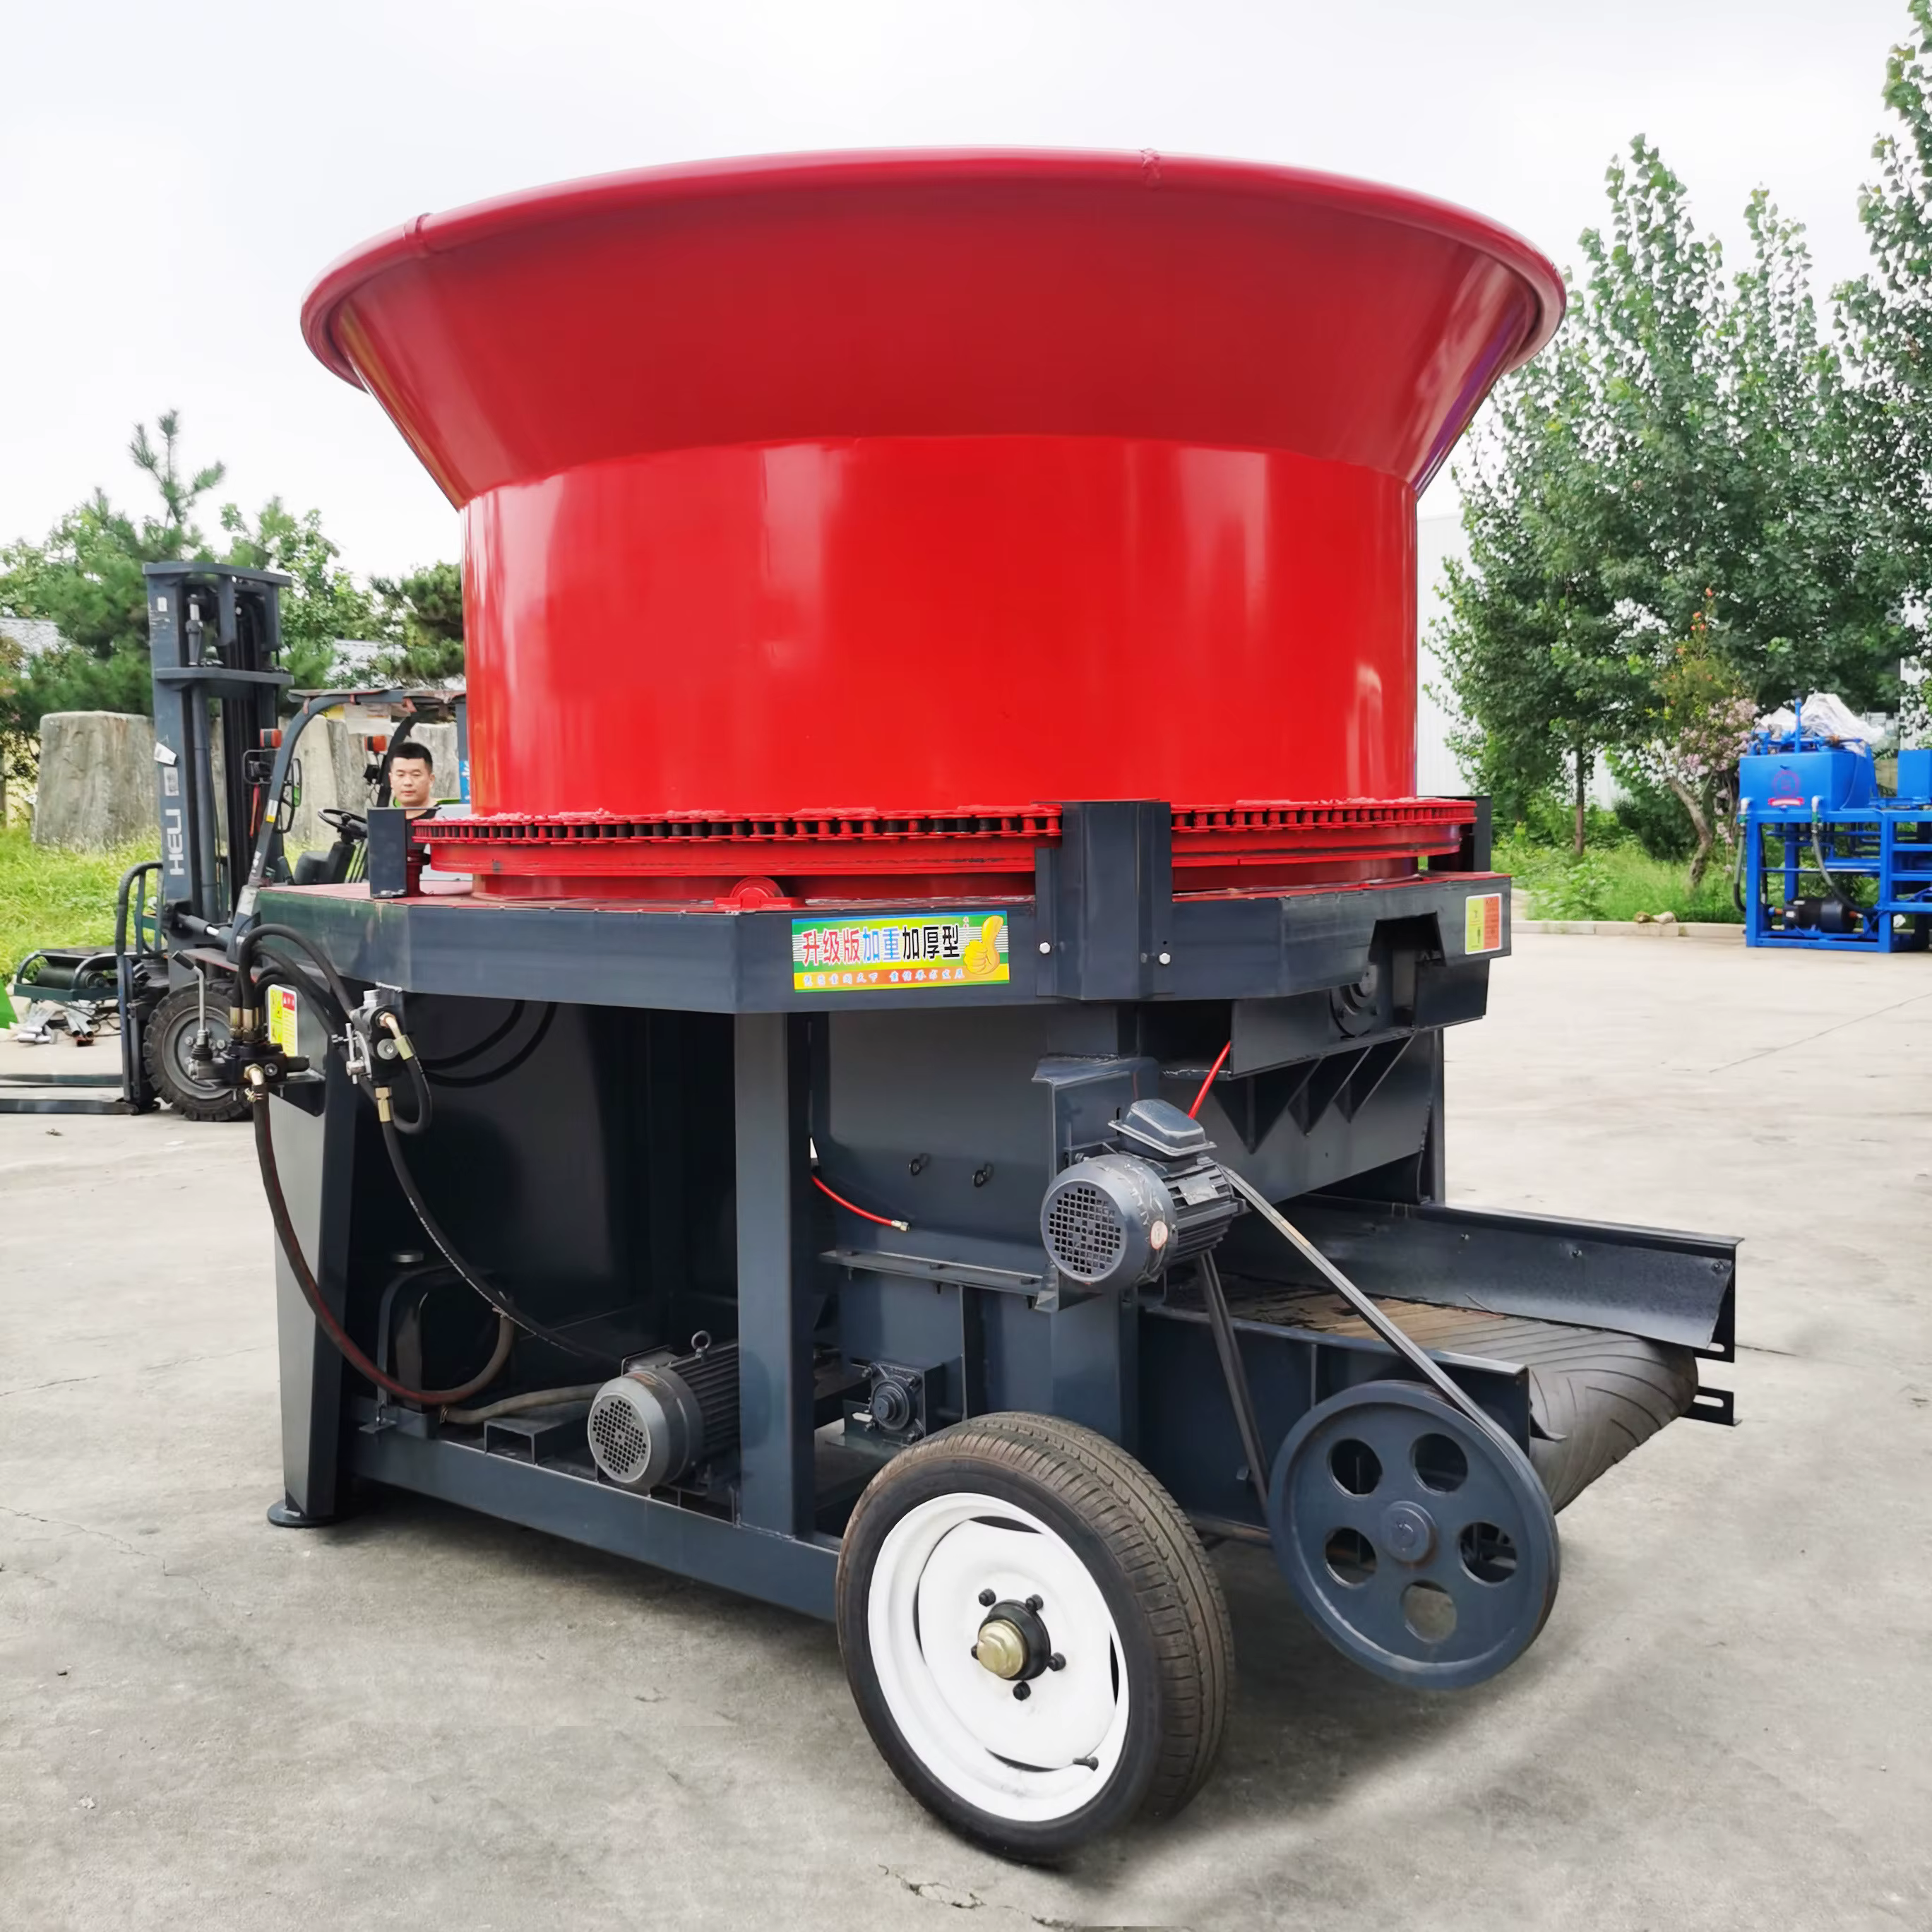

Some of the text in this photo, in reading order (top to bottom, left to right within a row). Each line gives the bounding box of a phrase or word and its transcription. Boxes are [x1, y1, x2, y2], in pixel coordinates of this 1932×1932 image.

[165, 809, 184, 875] HELI
[802, 924, 960, 965] 升级版加重加厚型
